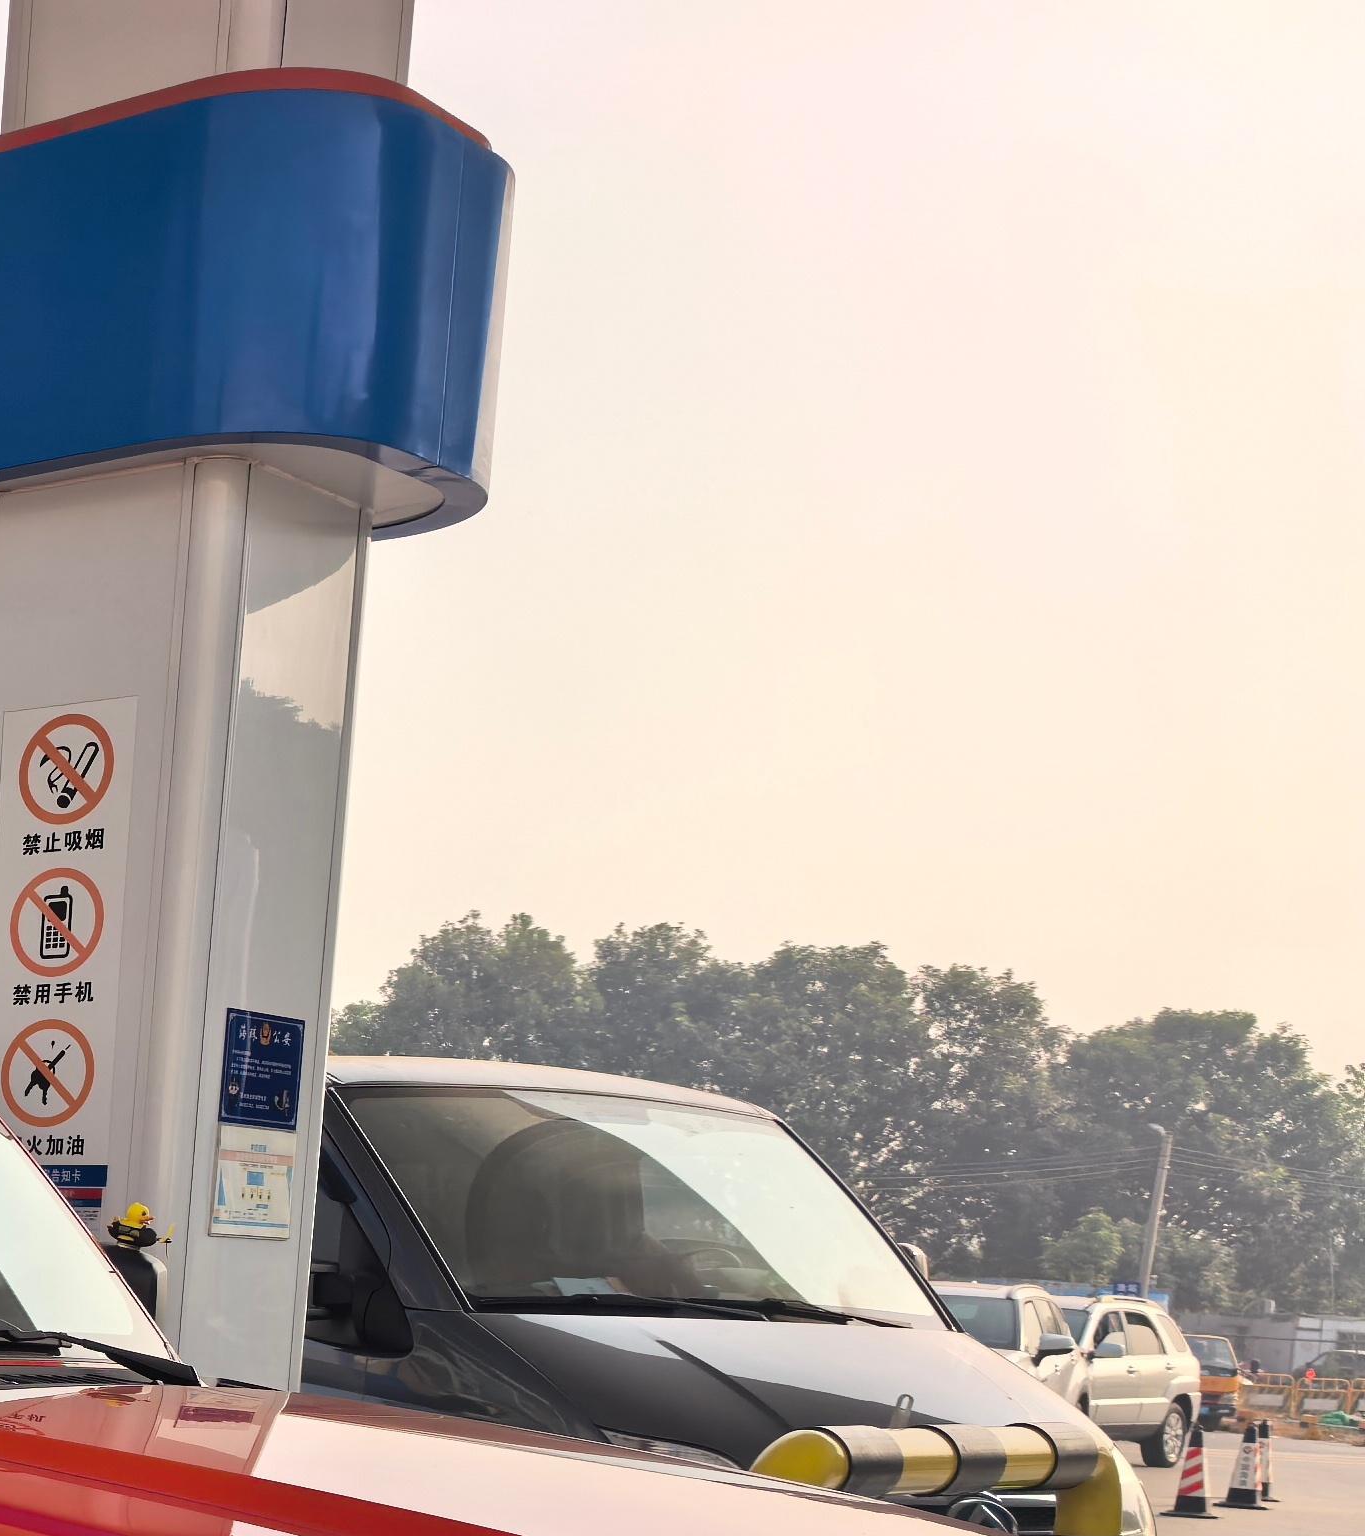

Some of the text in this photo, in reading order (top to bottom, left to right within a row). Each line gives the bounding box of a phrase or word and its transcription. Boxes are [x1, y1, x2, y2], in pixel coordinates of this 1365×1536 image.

[22, 828, 105, 856] 禁止吸烟
[12, 981, 94, 1006] 禁用手机
[17, 1134, 85, 1155] 火加油
